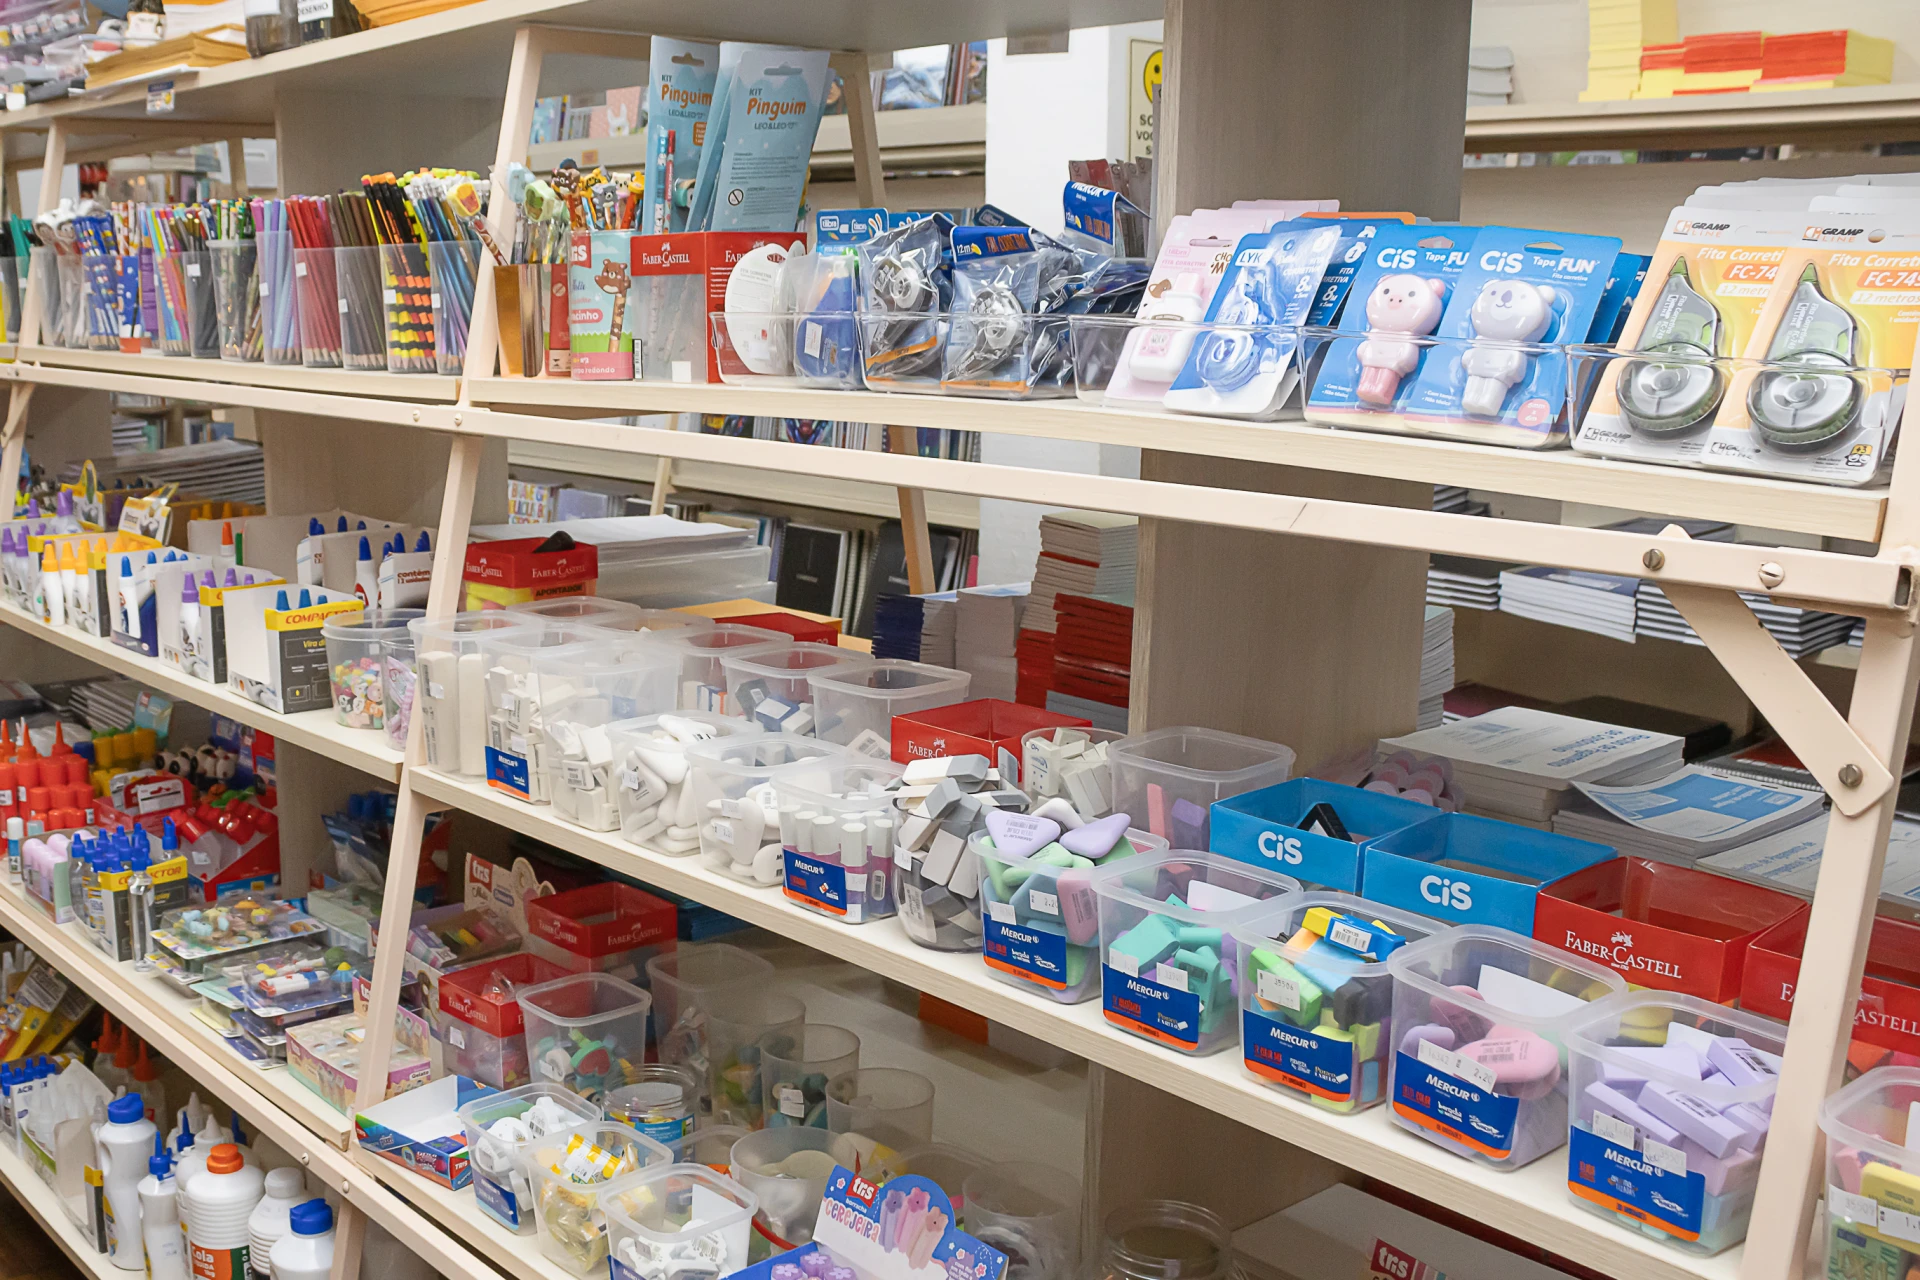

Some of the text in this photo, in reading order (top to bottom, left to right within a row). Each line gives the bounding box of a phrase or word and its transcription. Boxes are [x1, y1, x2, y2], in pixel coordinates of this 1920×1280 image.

[298, 2, 329, 15] ESENHO
[661, 74, 672, 82] KIT
[661, 84, 713, 109] Pinguim
[749, 88, 762, 96] KIT
[668, 109, 697, 118] LEO&LEO
[747, 97, 806, 121] Pinguim
[754, 122, 787, 130] LEO&LEO
[1691, 221, 1731, 231] GRAMP
[1821, 227, 1864, 237] GRAMP
[1692, 230, 1721, 238] LINE
[1822, 235, 1856, 243] LINE
[642, 251, 690, 265] FABER-CASTELL
[1239, 252, 1262, 264] LYK
[1376, 247, 1418, 270] CiS
[1425, 252, 1445, 264] Tape
[1449, 251, 1470, 266] FU
[1480, 250, 1524, 274] CiS
[1533, 256, 1556, 268] Tape
[1696, 248, 1785, 262] Fita Correti
[1828, 254, 1859, 266] Fita
[1339, 267, 1354, 275] FITA
[1558, 257, 1596, 274] FUN
[1729, 264, 1777, 279] FC-74
[1552, 272, 1588, 282] Fita corretiva
[1665, 295, 1688, 335] Fita Corretiva
[1797, 303, 1819, 343] Fita Corretiva
[585, 366, 616, 374] redondo
[397, 569, 431, 578] contém
[535, 583, 583, 597] APONTADOR
[1257, 831, 1303, 865] CiS
[472, 860, 490, 883] tris
[794, 859, 819, 875] MERCUR
[1420, 875, 1473, 911] CiS
[607, 926, 662, 946] FABER-CASTELL
[1001, 926, 1033, 944] MERCUR
[1565, 930, 1682, 979] FABER-CASTELL
[1127, 979, 1162, 1000] MERCUR
[1270, 1026, 1310, 1049] MERCUR
[412, 1070, 430, 1079] Gelato
[1425, 1073, 1470, 1101] MERCUR
[1604, 1148, 1653, 1176] MERCUR
[852, 1176, 875, 1201] tris
[845, 1197, 867, 1214] borracha
[1379, 1247, 1409, 1279] tris
